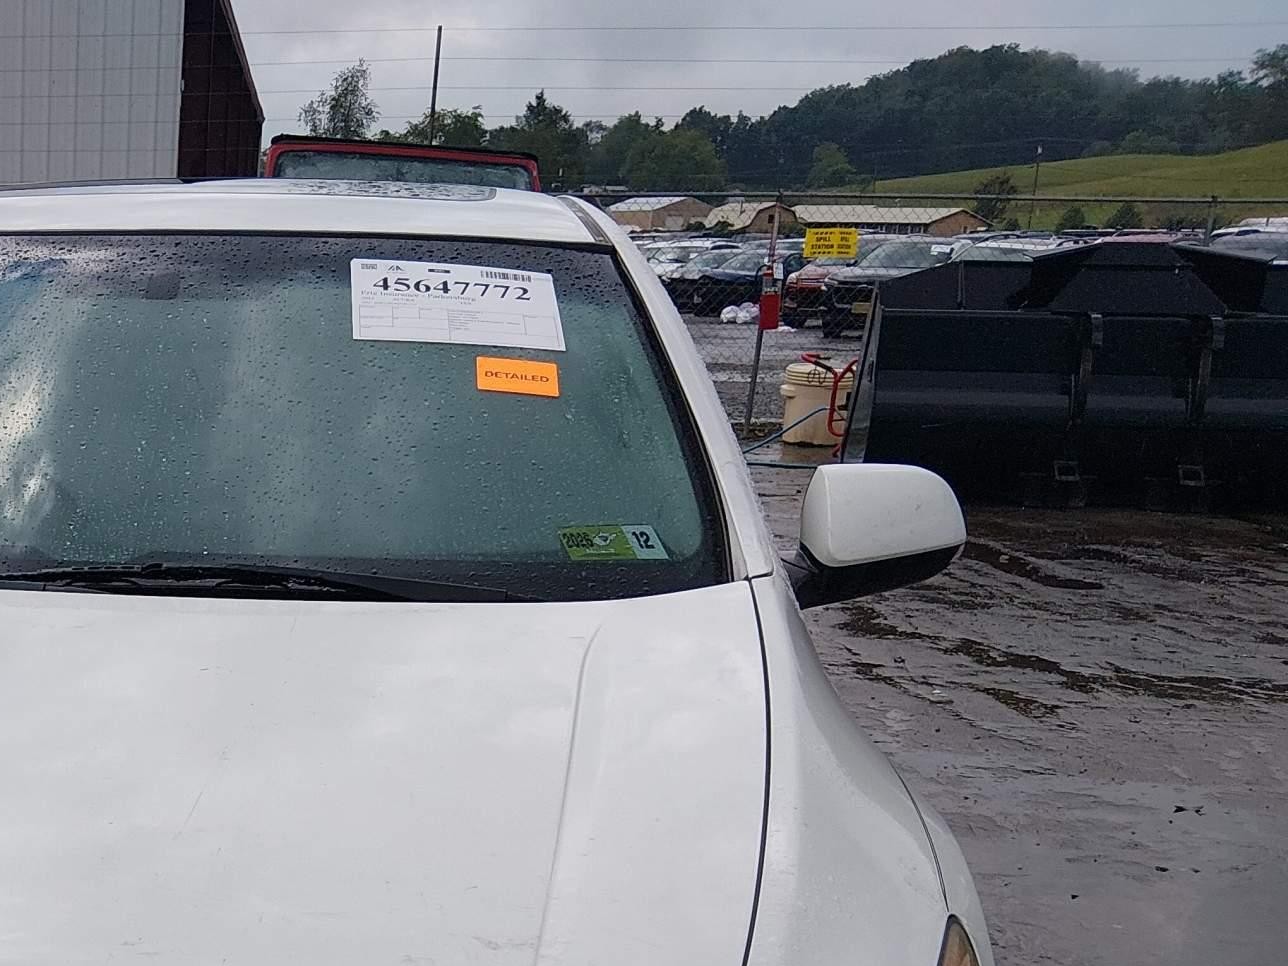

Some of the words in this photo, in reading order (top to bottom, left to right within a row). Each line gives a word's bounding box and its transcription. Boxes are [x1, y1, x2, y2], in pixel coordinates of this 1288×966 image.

[373, 276, 532, 301] 45647772
[484, 370, 550, 383] DETAILED
[631, 531, 656, 550] 12
